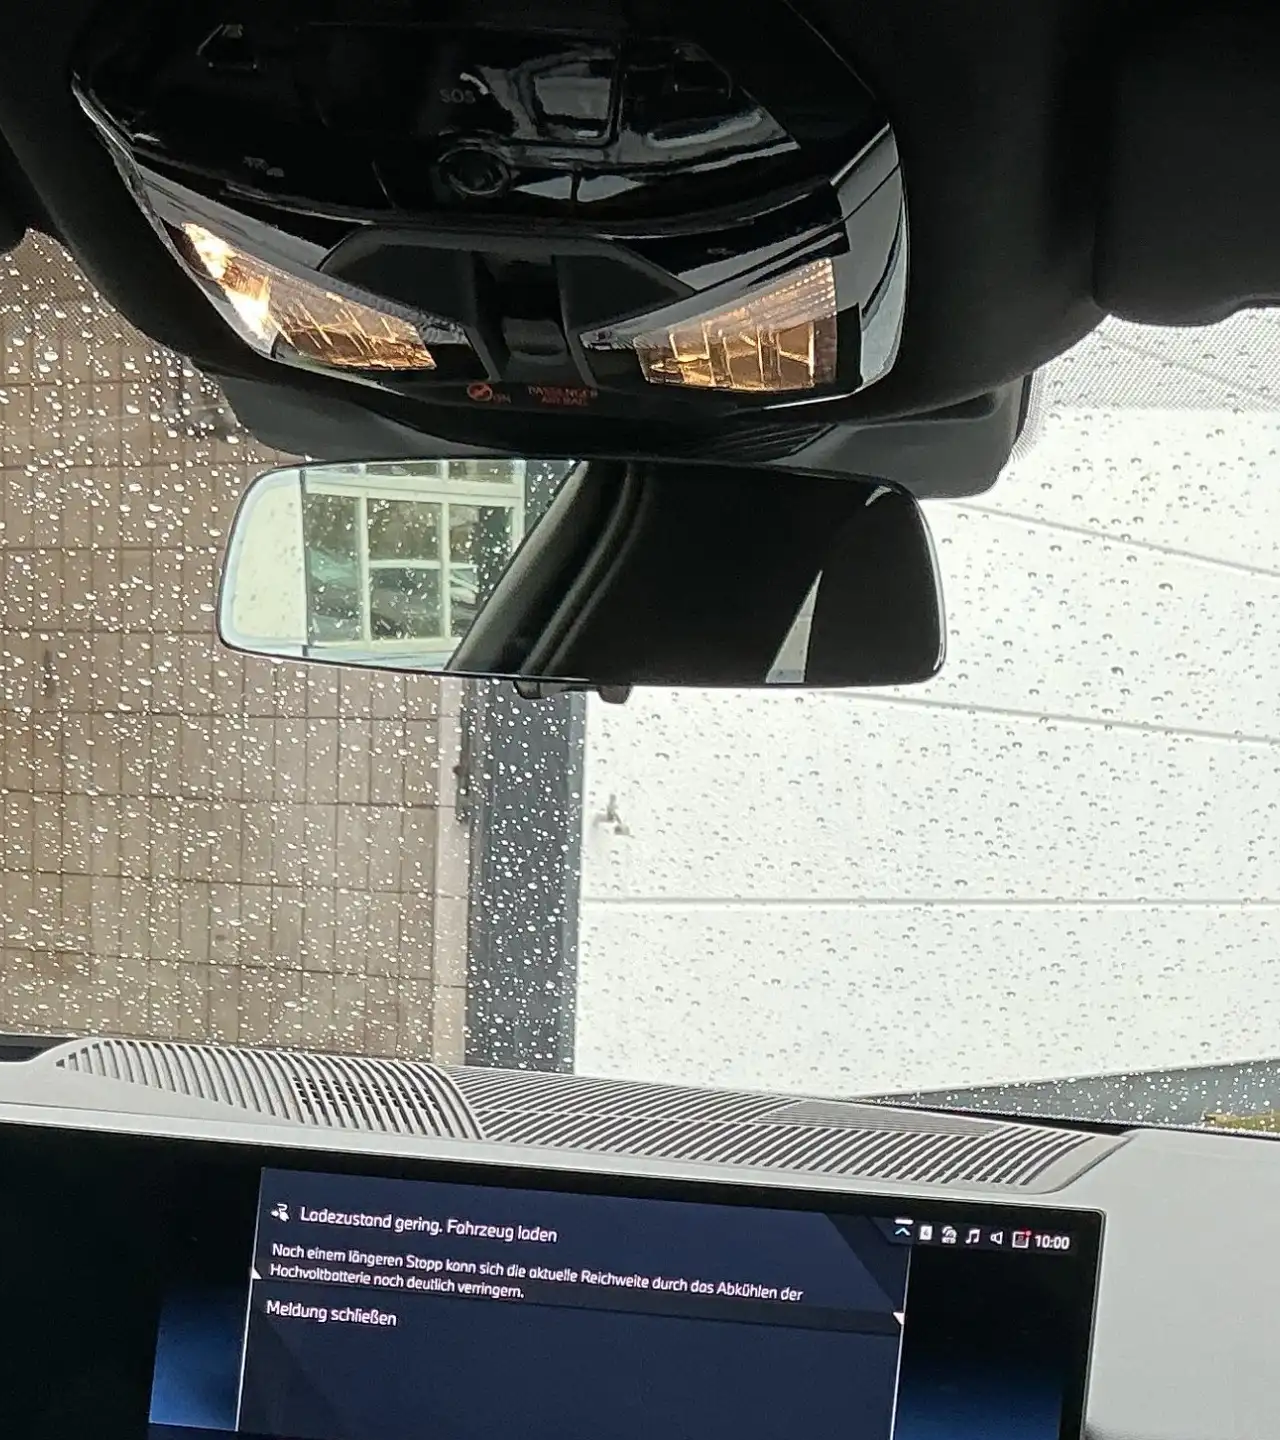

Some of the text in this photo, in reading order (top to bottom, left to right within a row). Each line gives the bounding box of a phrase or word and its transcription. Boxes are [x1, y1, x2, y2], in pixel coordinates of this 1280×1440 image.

[300, 1206, 558, 1242] Ladezustand gering. Fahrzeug laden
[1034, 1234, 1071, 1250] 10:00
[270, 1263, 371, 1285] Hochvoltbatterie
[373, 1272, 404, 1288] noch
[406, 1276, 455, 1293] deutlich
[272, 1243, 804, 1301] Nach einem längeren Stopp kann sich die aktuelle Reichweite durch das Abkühlen der
[266, 1300, 398, 1327] Meldung schließen
